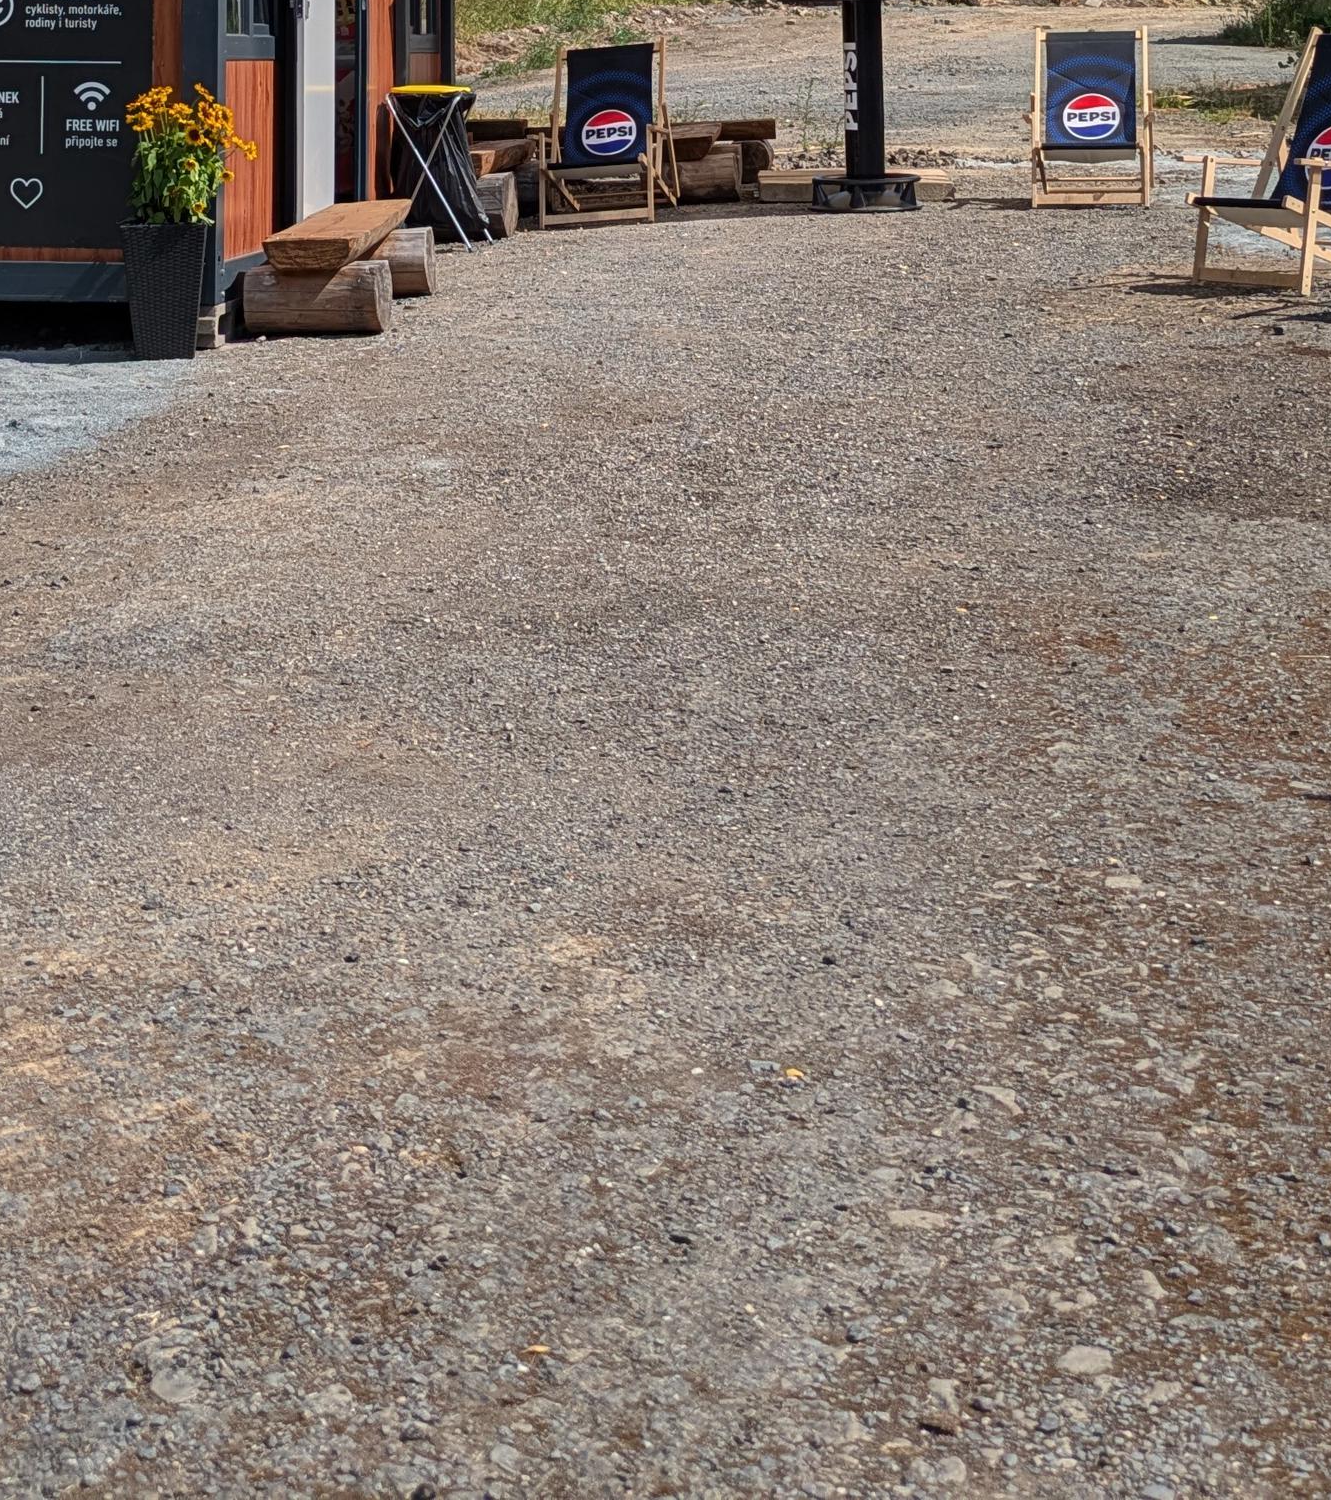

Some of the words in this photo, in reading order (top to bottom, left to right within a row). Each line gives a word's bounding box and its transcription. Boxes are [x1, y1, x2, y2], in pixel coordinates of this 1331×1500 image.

[26, 4, 65, 18] cyklisty,
[69, 4, 121, 15] motorkáře,
[26, 17, 55, 30] rodiny
[58, 16, 62, 28] i
[64, 18, 97, 30] turisty
[843, 42, 859, 131] PEPSI
[1067, 111, 1116, 122] PEPSI
[66, 119, 93, 134] FREE
[96, 119, 121, 134] WIFI
[585, 126, 633, 140] PEPSI
[66, 136, 103, 148] připojte
[106, 137, 118, 147] se
